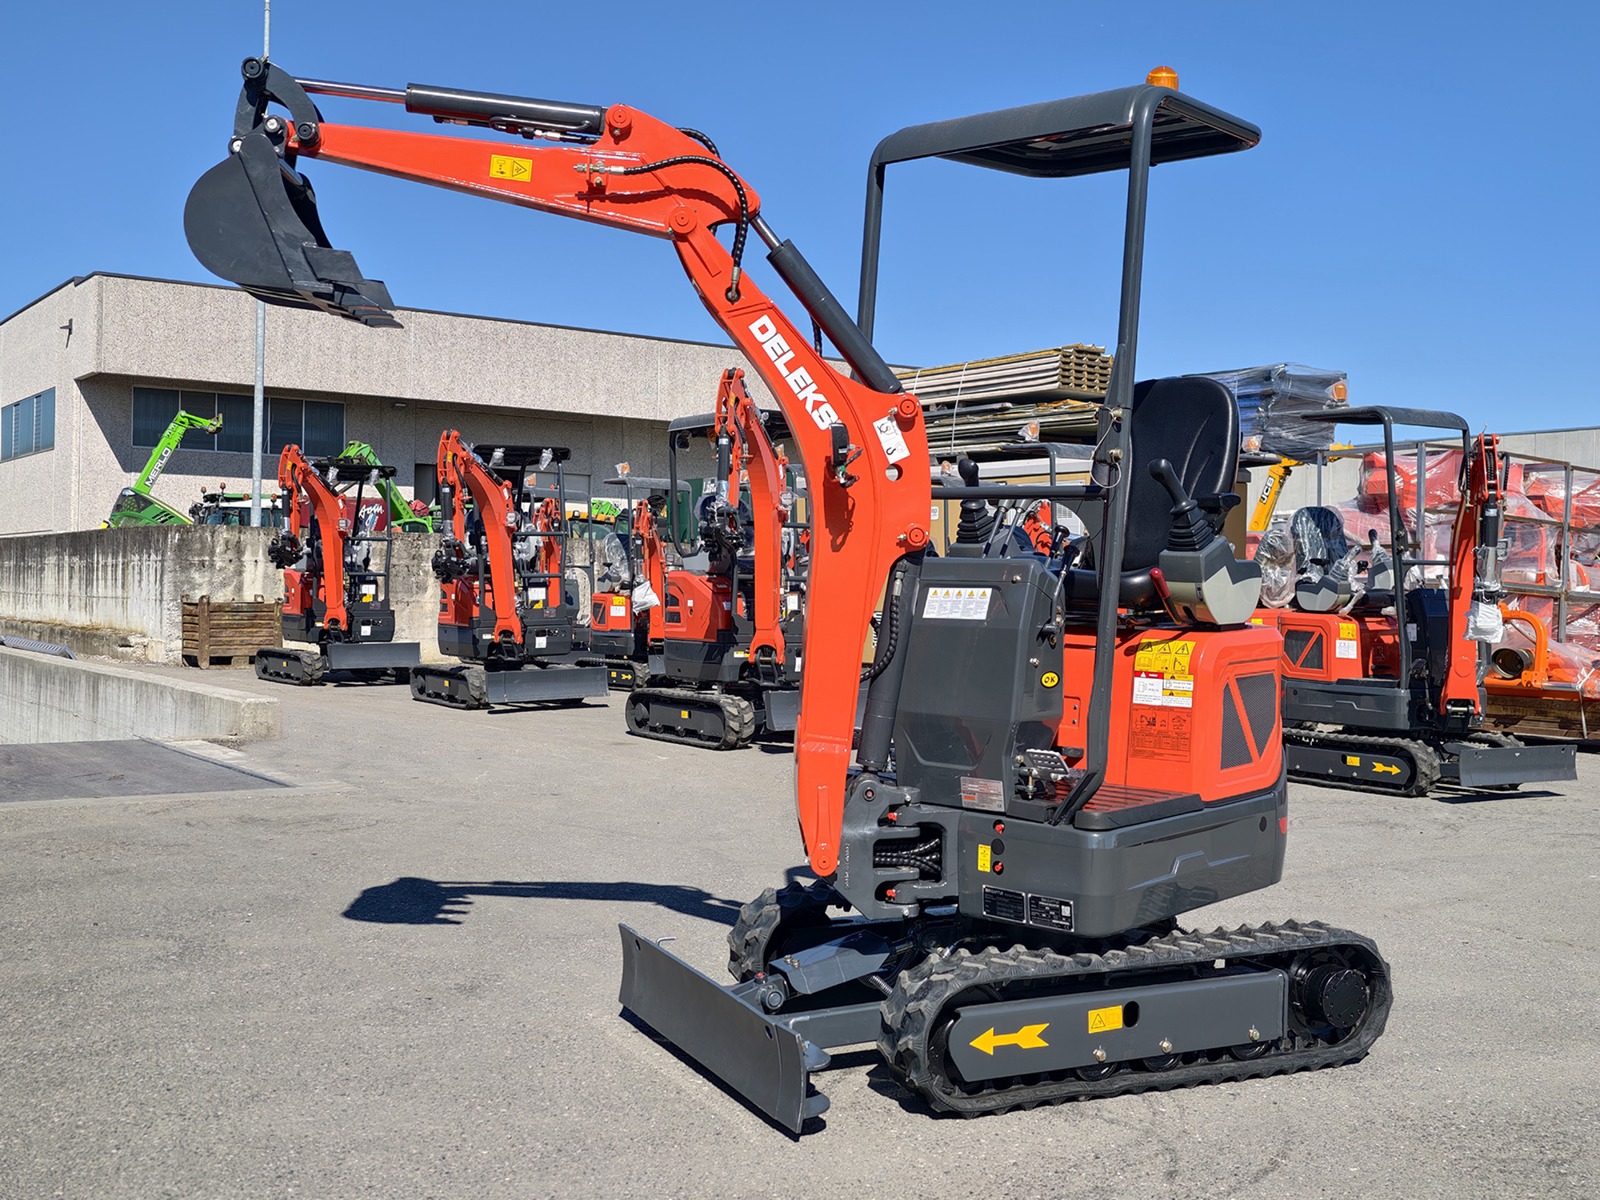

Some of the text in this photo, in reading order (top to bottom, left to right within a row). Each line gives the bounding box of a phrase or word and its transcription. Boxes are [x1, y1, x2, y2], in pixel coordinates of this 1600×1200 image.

[747, 314, 840, 431] DELEKS
[144, 447, 172, 487] MERLO
[1261, 477, 1274, 503] JCB
[1043, 675, 1056, 685] OK
